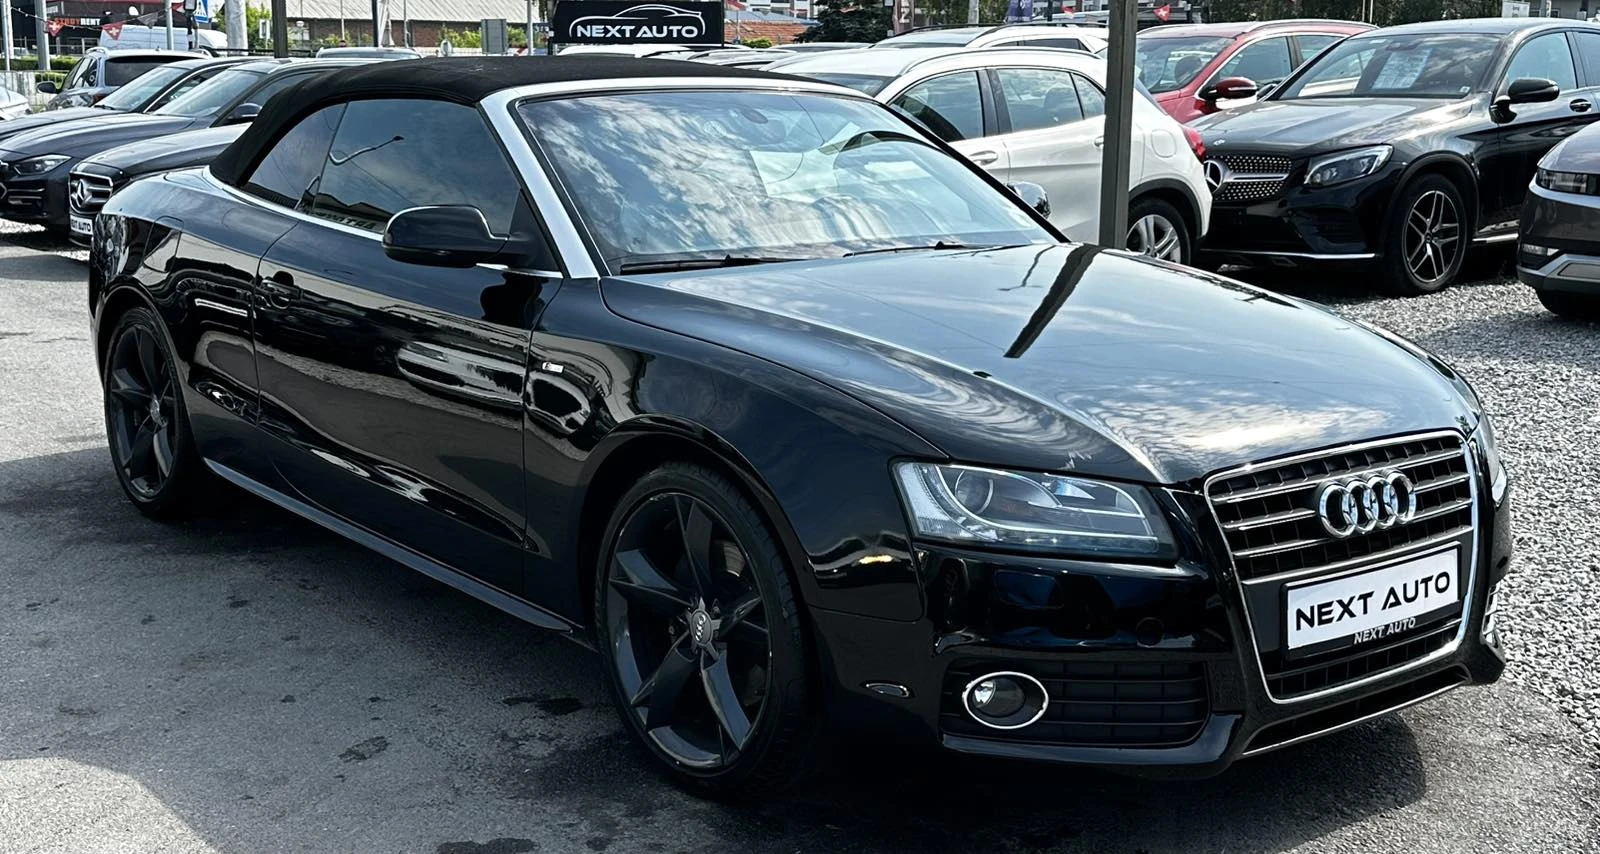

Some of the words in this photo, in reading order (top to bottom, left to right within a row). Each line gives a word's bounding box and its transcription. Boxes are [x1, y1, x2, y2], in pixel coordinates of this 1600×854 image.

[576, 25, 636, 38] NEXT
[636, 25, 699, 38] AUTO
[1295, 590, 1375, 631] NEXT
[1381, 571, 1450, 611] AUTO
[1353, 627, 1386, 645] NEXT
[1386, 617, 1417, 636] AUTO
